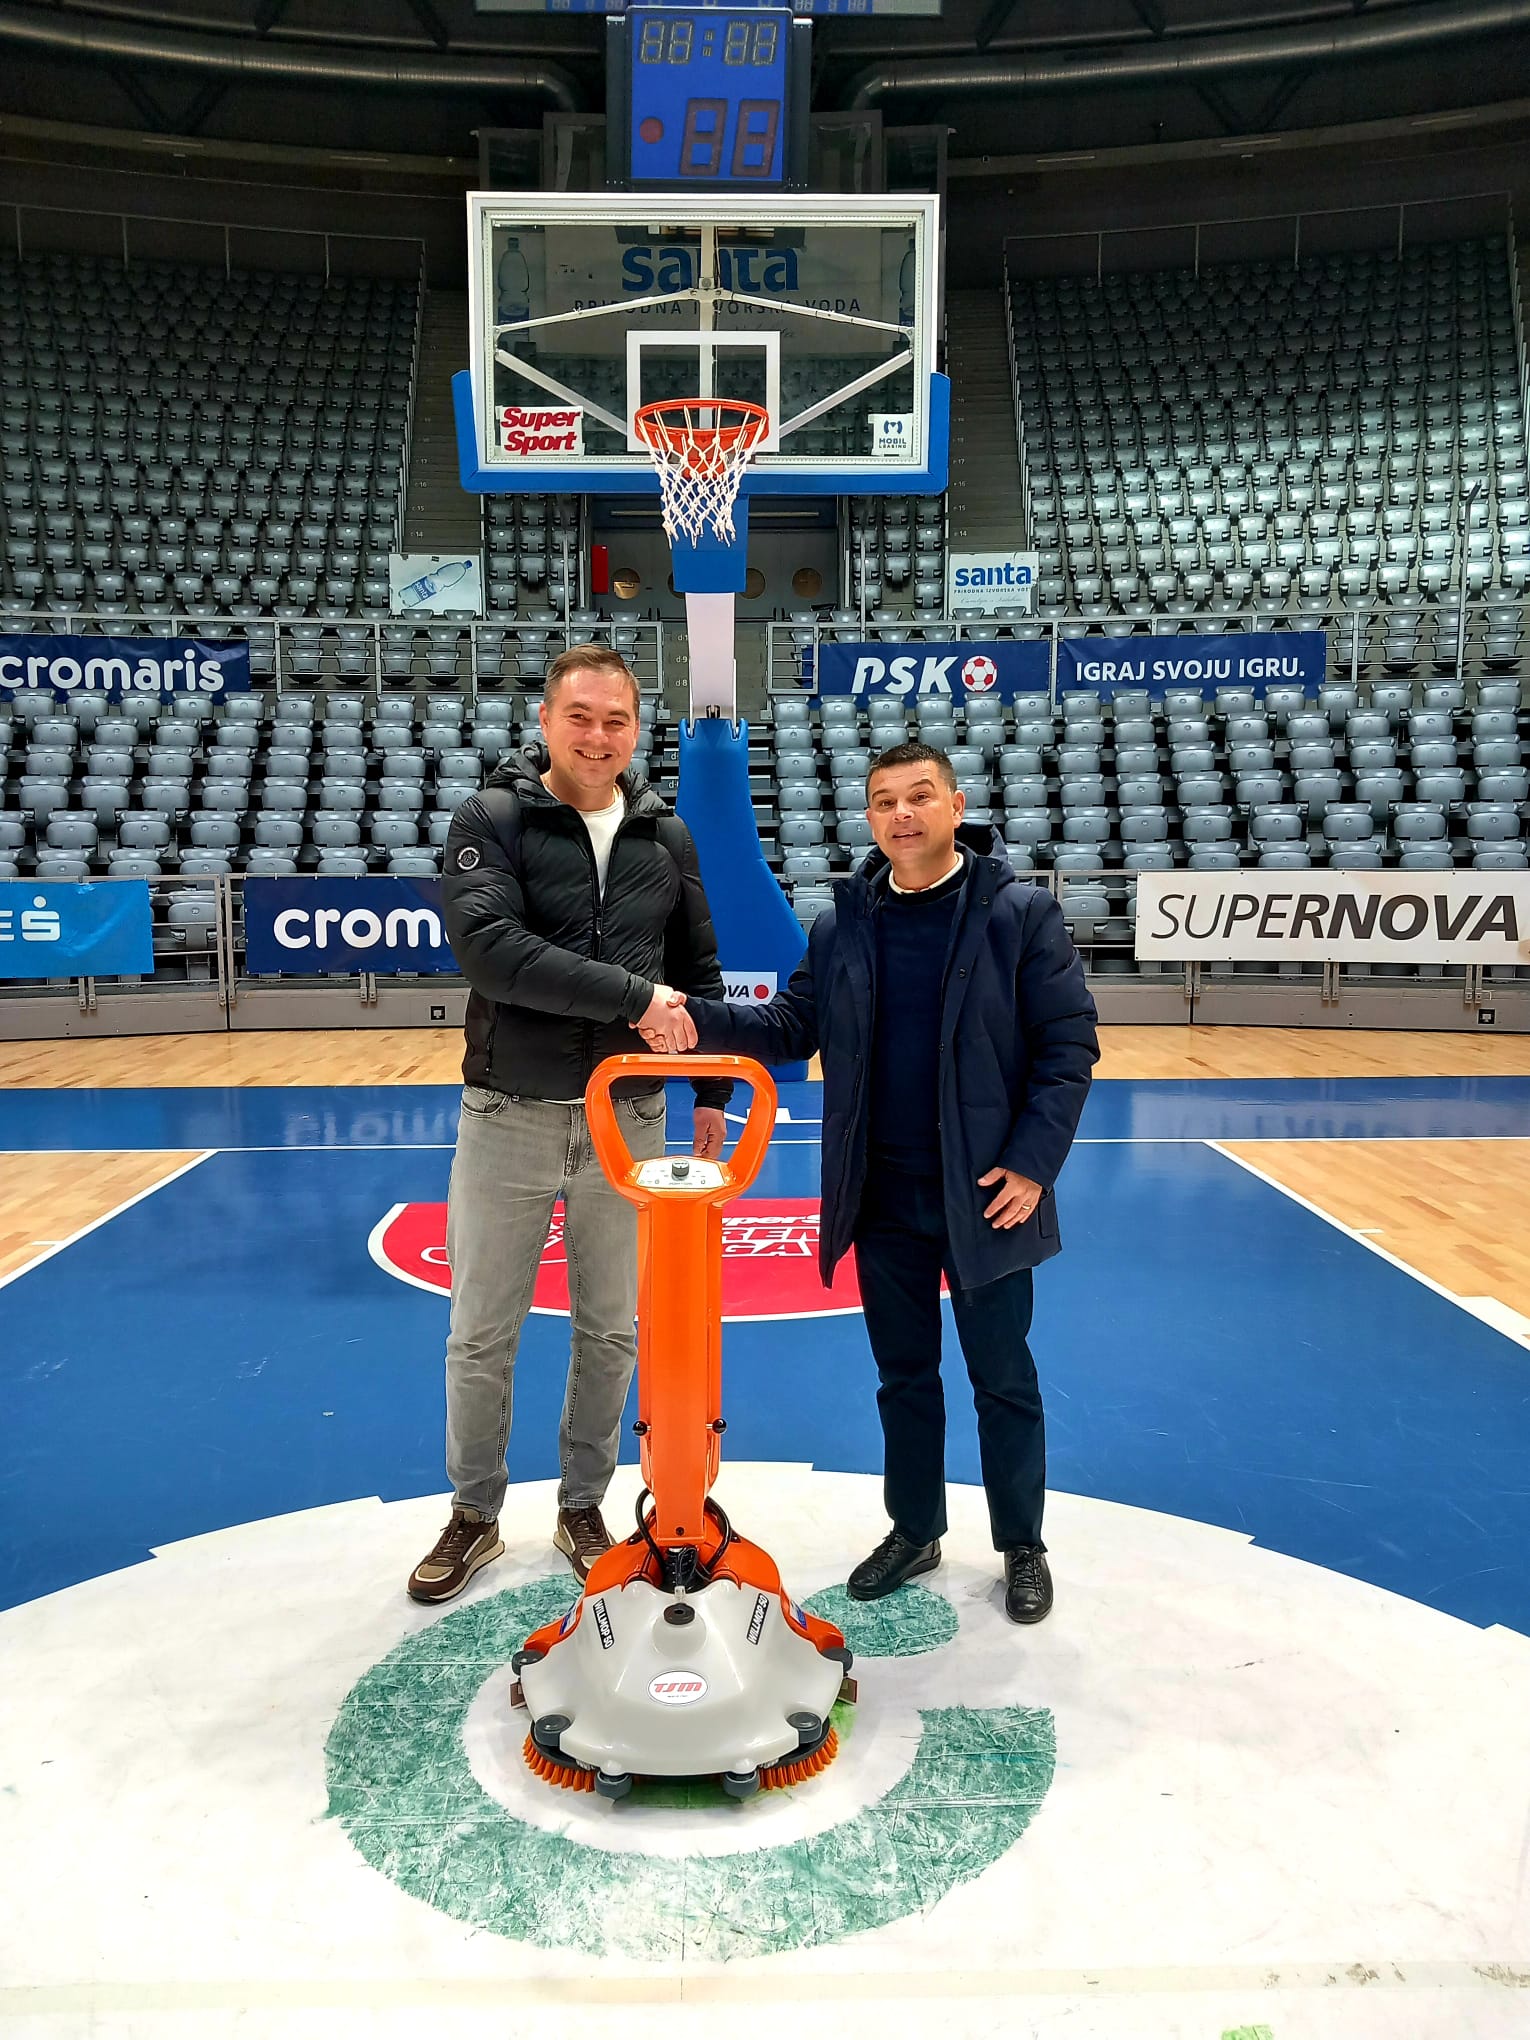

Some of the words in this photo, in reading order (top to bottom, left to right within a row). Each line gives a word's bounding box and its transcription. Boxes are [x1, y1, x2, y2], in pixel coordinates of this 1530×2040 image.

[501, 408, 581, 431] Super
[504, 431, 577, 455] Sport
[955, 562, 1031, 586] santa
[0, 649, 224, 691] cromaris
[851, 656, 958, 694] PSK
[1076, 660, 1145, 682] IGRAJ
[1152, 658, 1234, 680] SVOJU
[1239, 656, 1306, 679] IGRU.
[273, 908, 450, 949] crom
[1151, 893, 1520, 941] SUPERNOVA
[594, 1600, 611, 1637] WILLMOP
[603, 1634, 613, 1648] 50
[747, 1604, 765, 1644] WILLMOP
[758, 1594, 768, 1608] 50
